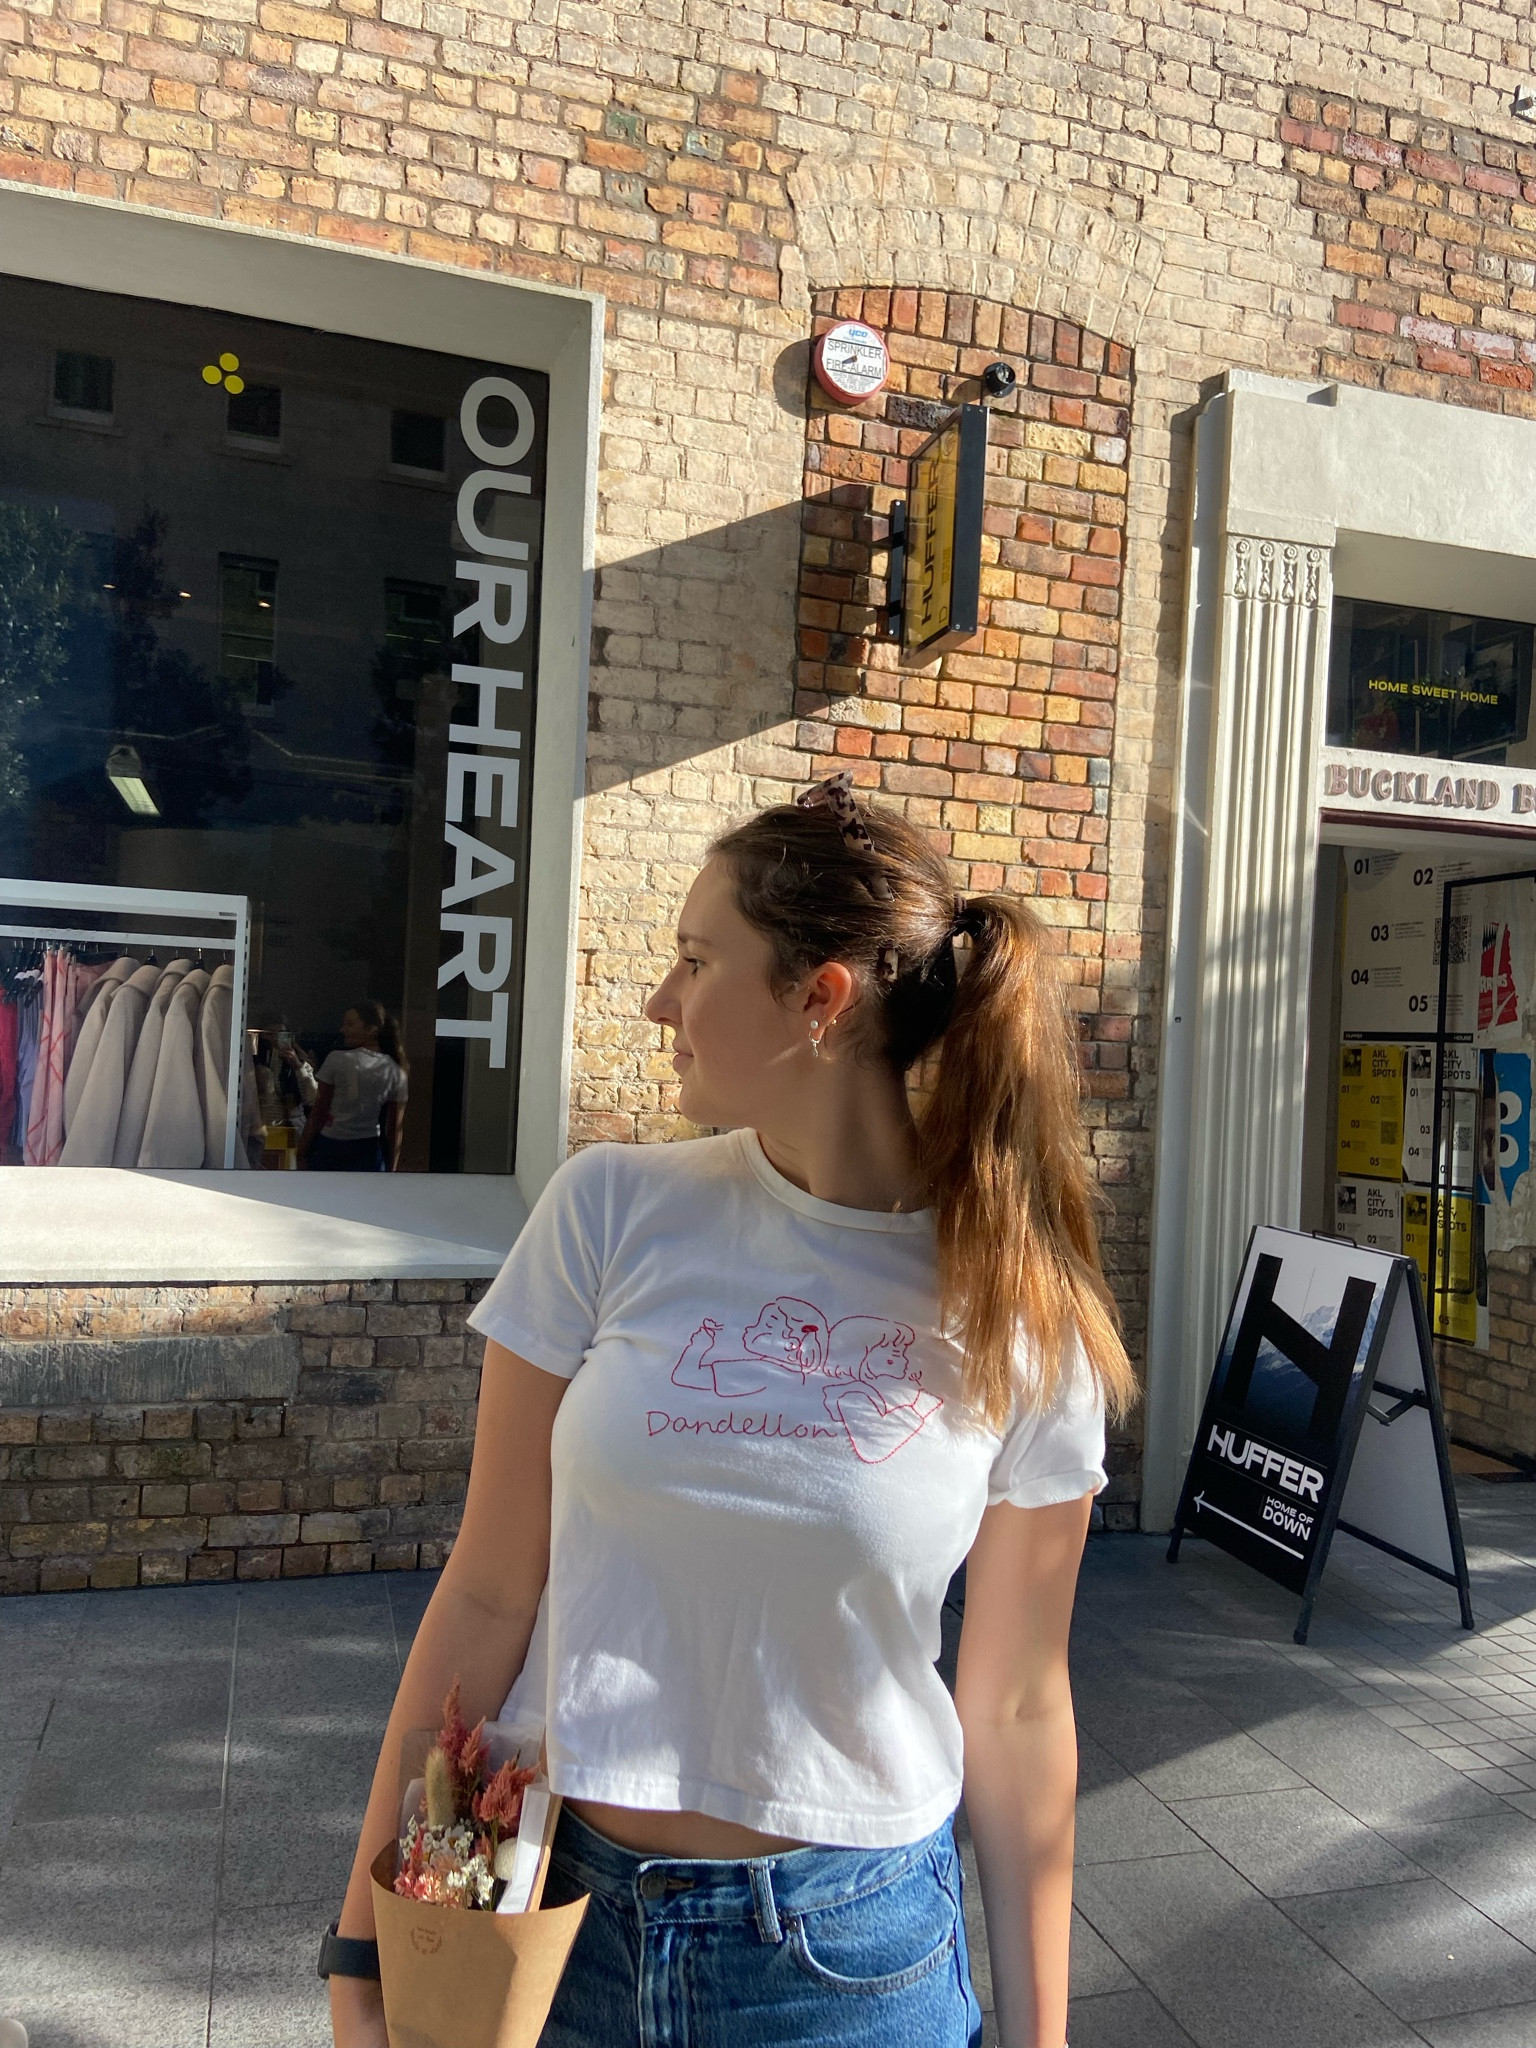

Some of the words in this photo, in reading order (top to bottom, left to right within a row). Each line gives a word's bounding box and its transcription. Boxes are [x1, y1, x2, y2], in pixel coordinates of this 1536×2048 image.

[827, 340, 882, 360] SPRINKLER
[826, 358, 882, 377] FIRE-ALARM
[453, 376, 535, 644] OUR
[921, 436, 943, 626] HUFFER
[1368, 679, 1408, 694] HOME
[1412, 684, 1457, 700] SWEET
[1460, 690, 1498, 705] HOME
[1324, 763, 1501, 810] BUCKLAND
[1512, 783, 1536, 813] B
[435, 663, 524, 1068] HEART
[1354, 858, 1370, 875] 01
[1413, 868, 1433, 886] 02
[1370, 924, 1389, 942] 03
[1351, 969, 1369, 985] 04
[1408, 995, 1428, 1012] 05
[1372, 1050, 1387, 1058] AKL
[1372, 1059, 1389, 1068] CITY
[1372, 1068, 1397, 1079] SPOTS
[1410, 1088, 1419, 1097] 01
[1370, 1096, 1380, 1104] 02
[1350, 1119, 1361, 1128] 03
[1420, 1125, 1431, 1134] 03
[1408, 1147, 1420, 1156] 04
[1370, 1157, 1380, 1166] 05
[1367, 1188, 1382, 1197] AKL
[1367, 1198, 1386, 1207] CITY
[1367, 1208, 1394, 1218] SPOTS
[1337, 1223, 1345, 1231] 01
[1367, 1235, 1377, 1244] 02
[1406, 1233, 1415, 1242] 01
[1207, 1424, 1324, 1503] HUFFER
[1266, 1496, 1297, 1518] HOME
[1298, 1513, 1314, 1524] OF
[1262, 1505, 1311, 1541] DOWN
